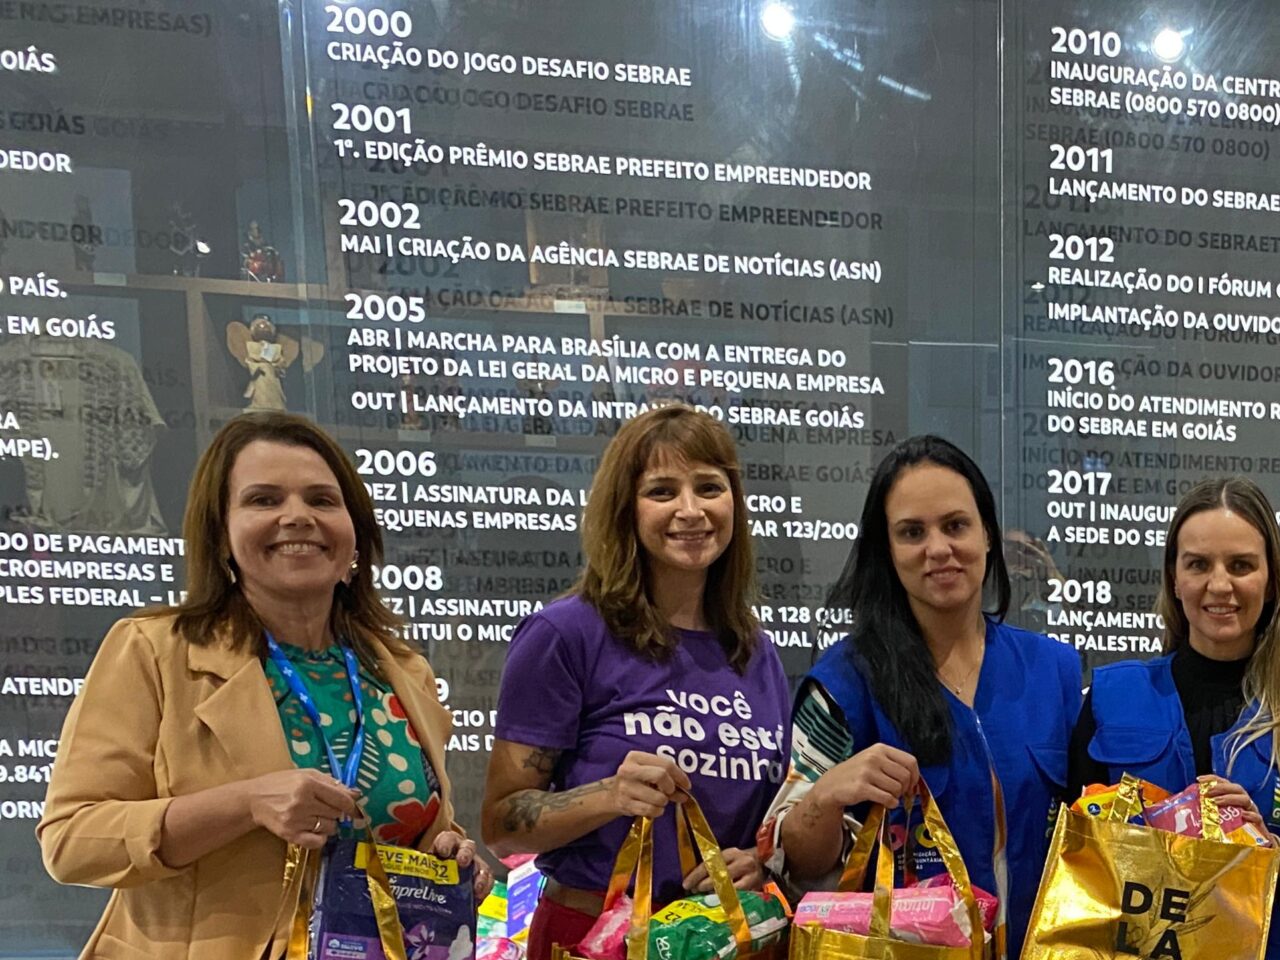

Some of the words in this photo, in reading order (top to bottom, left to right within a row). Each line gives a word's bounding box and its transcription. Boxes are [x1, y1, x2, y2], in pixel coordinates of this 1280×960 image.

[324, 5, 413, 38] 2000
[1051, 26, 1122, 58] 2010
[327, 40, 422, 70] CRIAÇÃO
[427, 48, 459, 69] DO
[463, 51, 517, 75] JOGO
[522, 56, 610, 81] DESAFIO
[614, 63, 692, 87] SEBRAE
[1050, 60, 1187, 92] INAUGURAÇÃO
[1190, 73, 1219, 93] DA
[331, 102, 412, 134] 2001
[1050, 86, 1121, 110] SEBRAE
[1125, 90, 1183, 115] (0800
[1186, 98, 1221, 119] 570
[364, 138, 444, 167] EDIÇÃO
[449, 142, 529, 169] PRÊMIO
[533, 151, 612, 175] SEBRAE
[615, 156, 710, 181] PREFEITO
[714, 163, 872, 191] EMPREENDEDOR
[1049, 143, 1113, 174] 2011
[1049, 177, 1177, 204] LANÇAMENTO
[1181, 187, 1209, 207] DO
[337, 198, 421, 230] 2002
[340, 233, 381, 254] MAI
[398, 235, 491, 264] CRIAÇÃO
[495, 242, 526, 263] DA
[530, 240, 620, 268] AGÊNCIA
[623, 249, 700, 272] SEBRAE
[703, 253, 730, 273] DE
[734, 251, 826, 278] NOTÍCIAS
[829, 258, 882, 284] (ASN)
[1048, 233, 1115, 263] 2012
[9, 271, 68, 298] PAÍS.
[1048, 266, 1163, 295] REALIZAÇÃO
[1166, 274, 1194, 293] DO
[1198, 276, 1204, 294] I
[1208, 272, 1272, 299] FÓRUM
[343, 293, 426, 323] 2005
[6, 315, 41, 336] EM
[45, 313, 116, 340] GOIÁS
[348, 353, 439, 379] PROJETO
[443, 358, 474, 377] DA
[477, 359, 507, 379] LEI
[511, 361, 578, 383] GERAL
[581, 363, 611, 383] DA
[615, 364, 679, 386] MICRO
[683, 368, 696, 387] E
[700, 368, 792, 393] PEQUENA
[796, 373, 885, 395] EMPRESA
[1047, 357, 1116, 387] 2016
[1047, 385, 1104, 410] INÍCIO
[1107, 391, 1135, 412] DO
[1138, 395, 1266, 419] ATENDIMENTO
[354, 448, 437, 477] 2006
[1047, 469, 1112, 496] 2017
[472, 511, 578, 532] EMPRESAS
[33, 533, 64, 552] DE
[67, 534, 185, 556] PAGAMENT
[49, 586, 146, 607] FEDERAL
[1047, 578, 1112, 604] 2018
[666, 689, 752, 720] você
[623, 705, 705, 741] não
